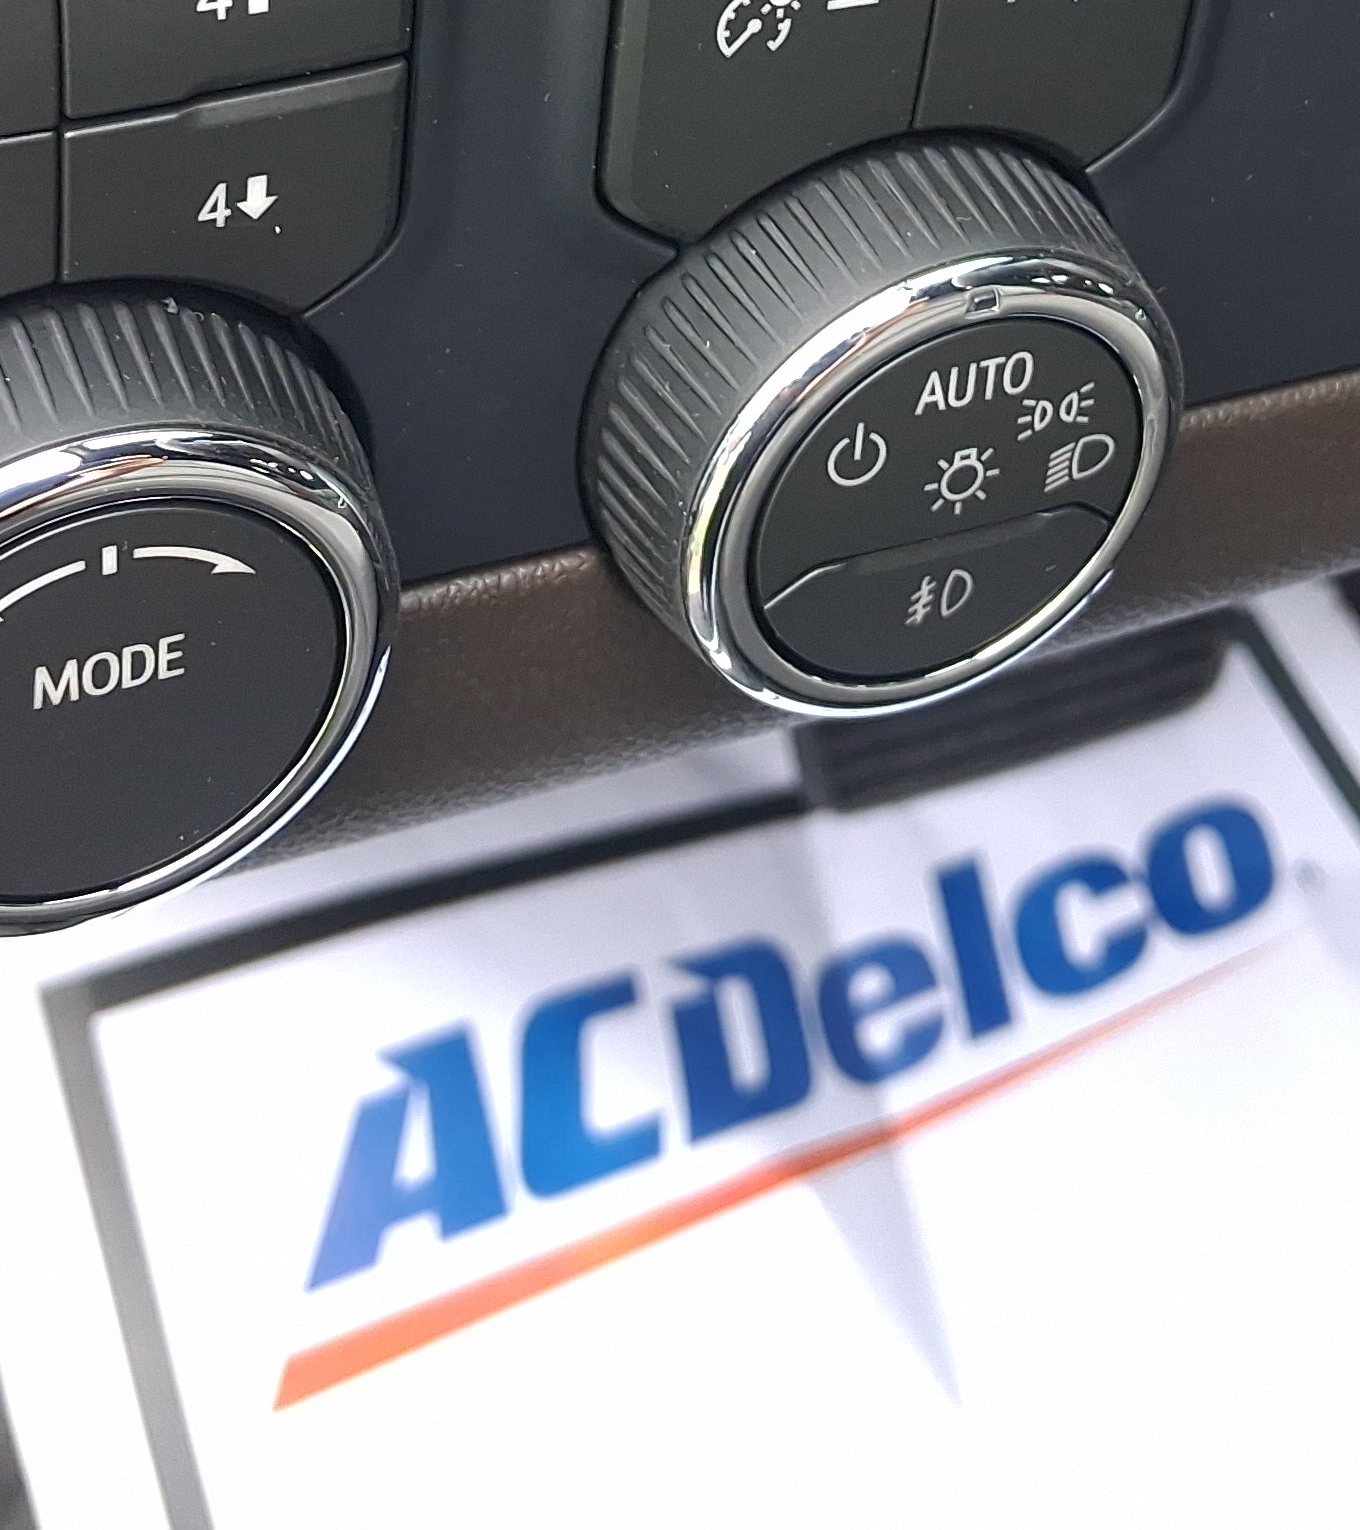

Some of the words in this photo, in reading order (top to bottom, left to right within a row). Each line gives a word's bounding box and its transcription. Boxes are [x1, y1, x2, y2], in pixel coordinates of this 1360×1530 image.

[914, 351, 1034, 416] AUTO
[33, 633, 185, 710] MODE
[304, 795, 1278, 1291] ACDelco
